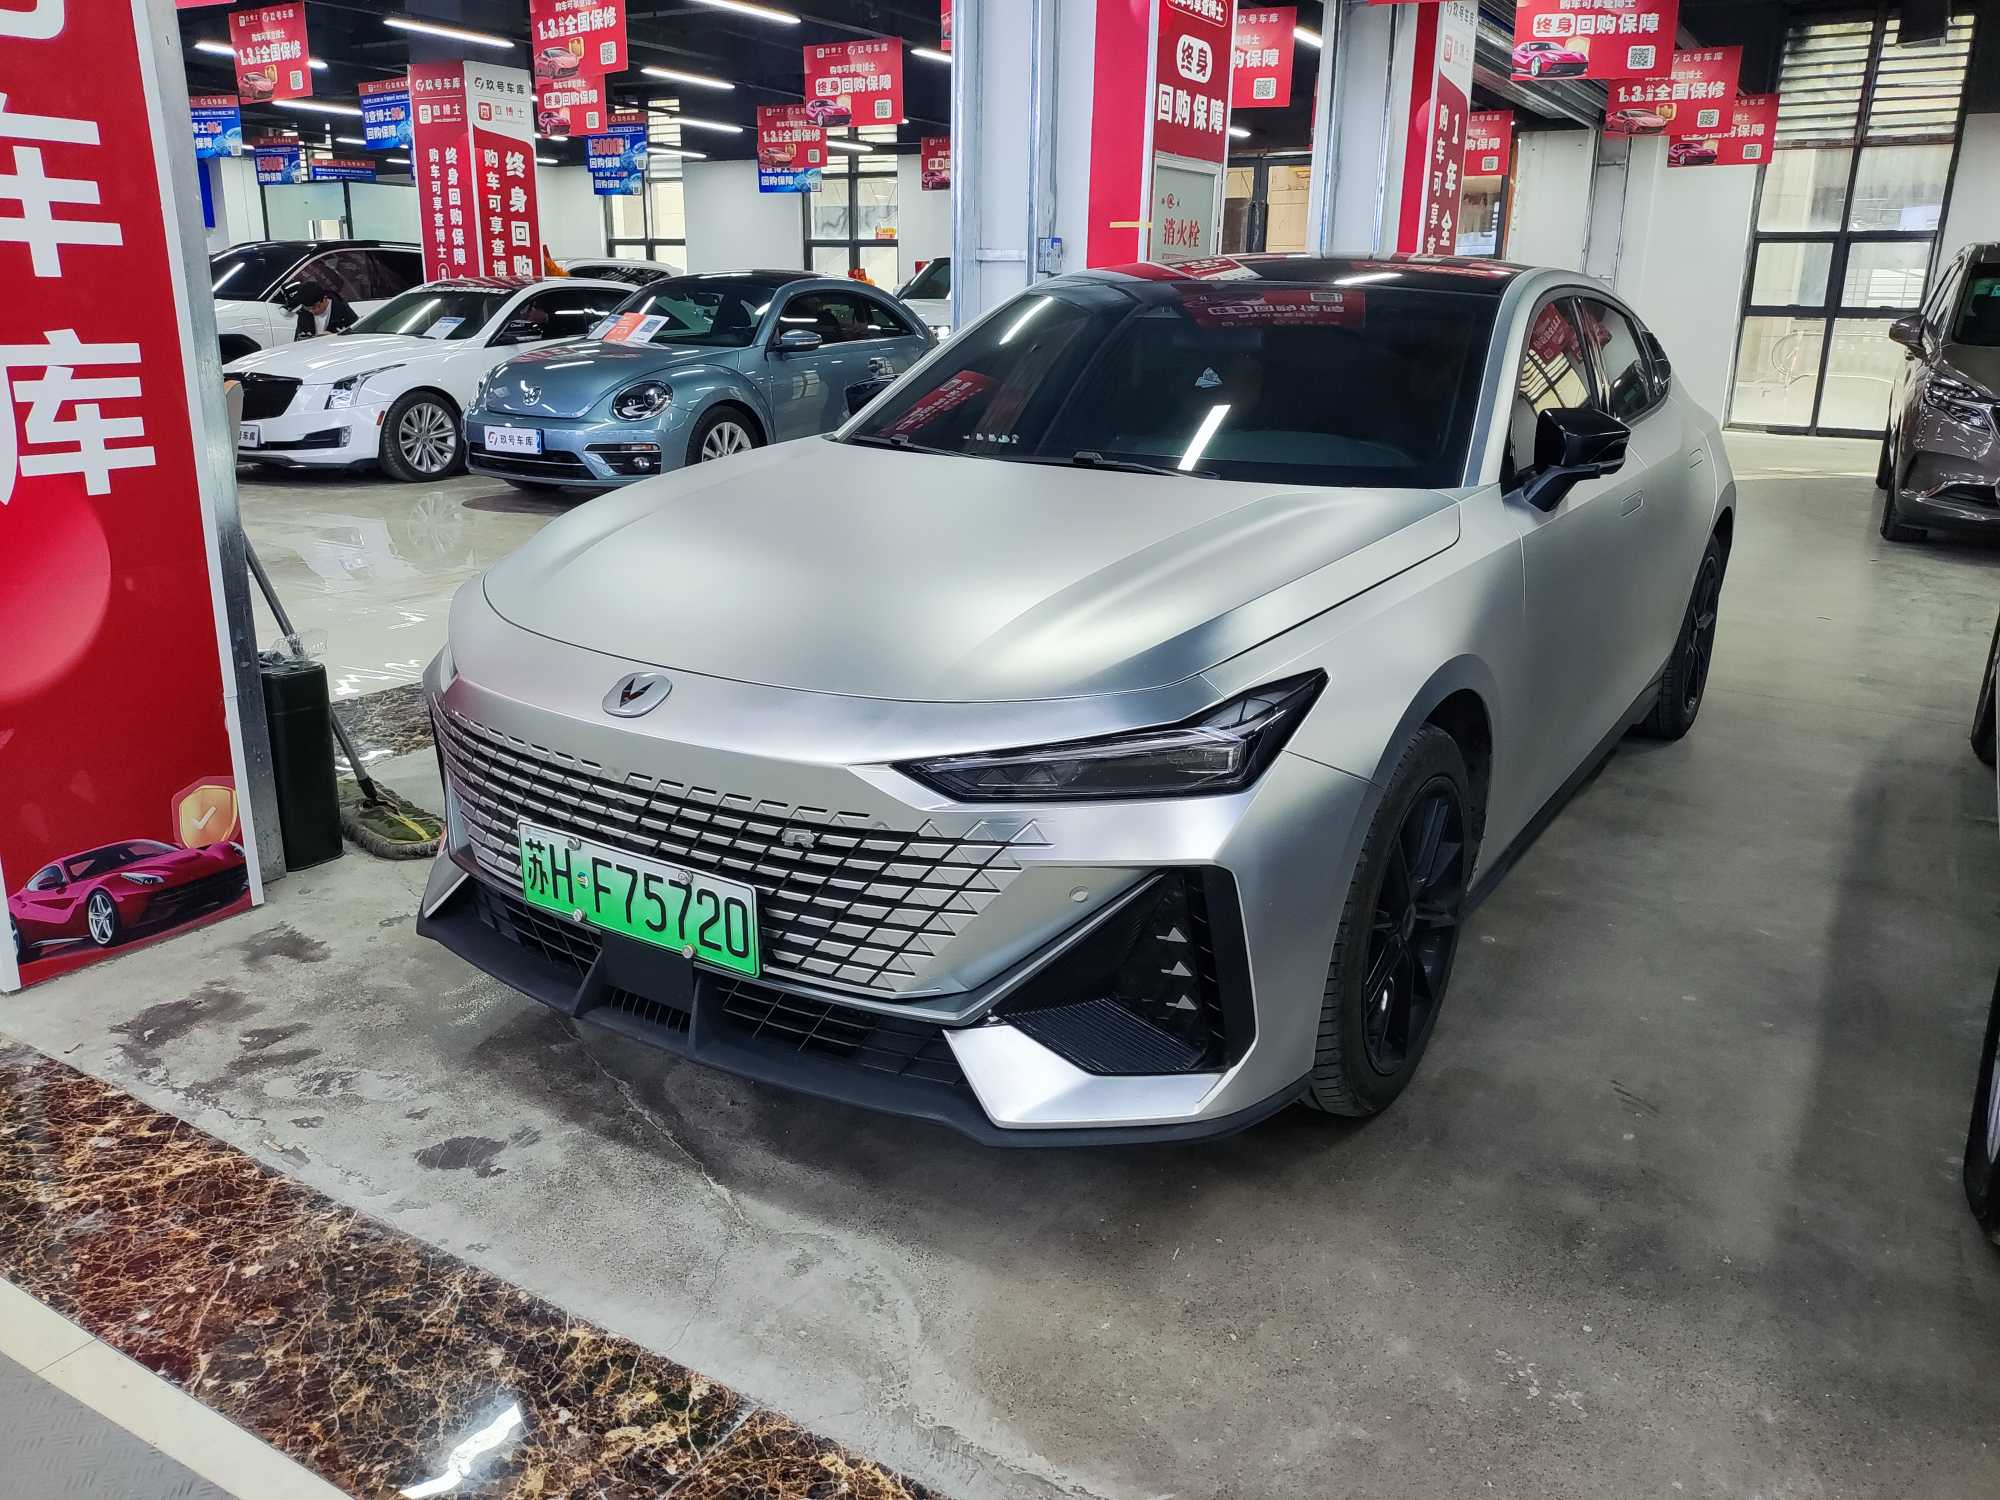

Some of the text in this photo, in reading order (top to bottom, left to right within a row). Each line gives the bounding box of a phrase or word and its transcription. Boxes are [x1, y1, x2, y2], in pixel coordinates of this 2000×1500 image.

[1534, 13, 1660, 37] 终身回购保障
[1180, 41, 1209, 78] 终身
[486, 79, 526, 96] 玖号车库
[816, 74, 892, 97] 终身回购保障
[1158, 84, 1224, 136] 回购保障
[428, 148, 448, 260] 购车可享查博士
[444, 147, 467, 267] 终身回购保障
[1163, 216, 1200, 249] 消火栓
